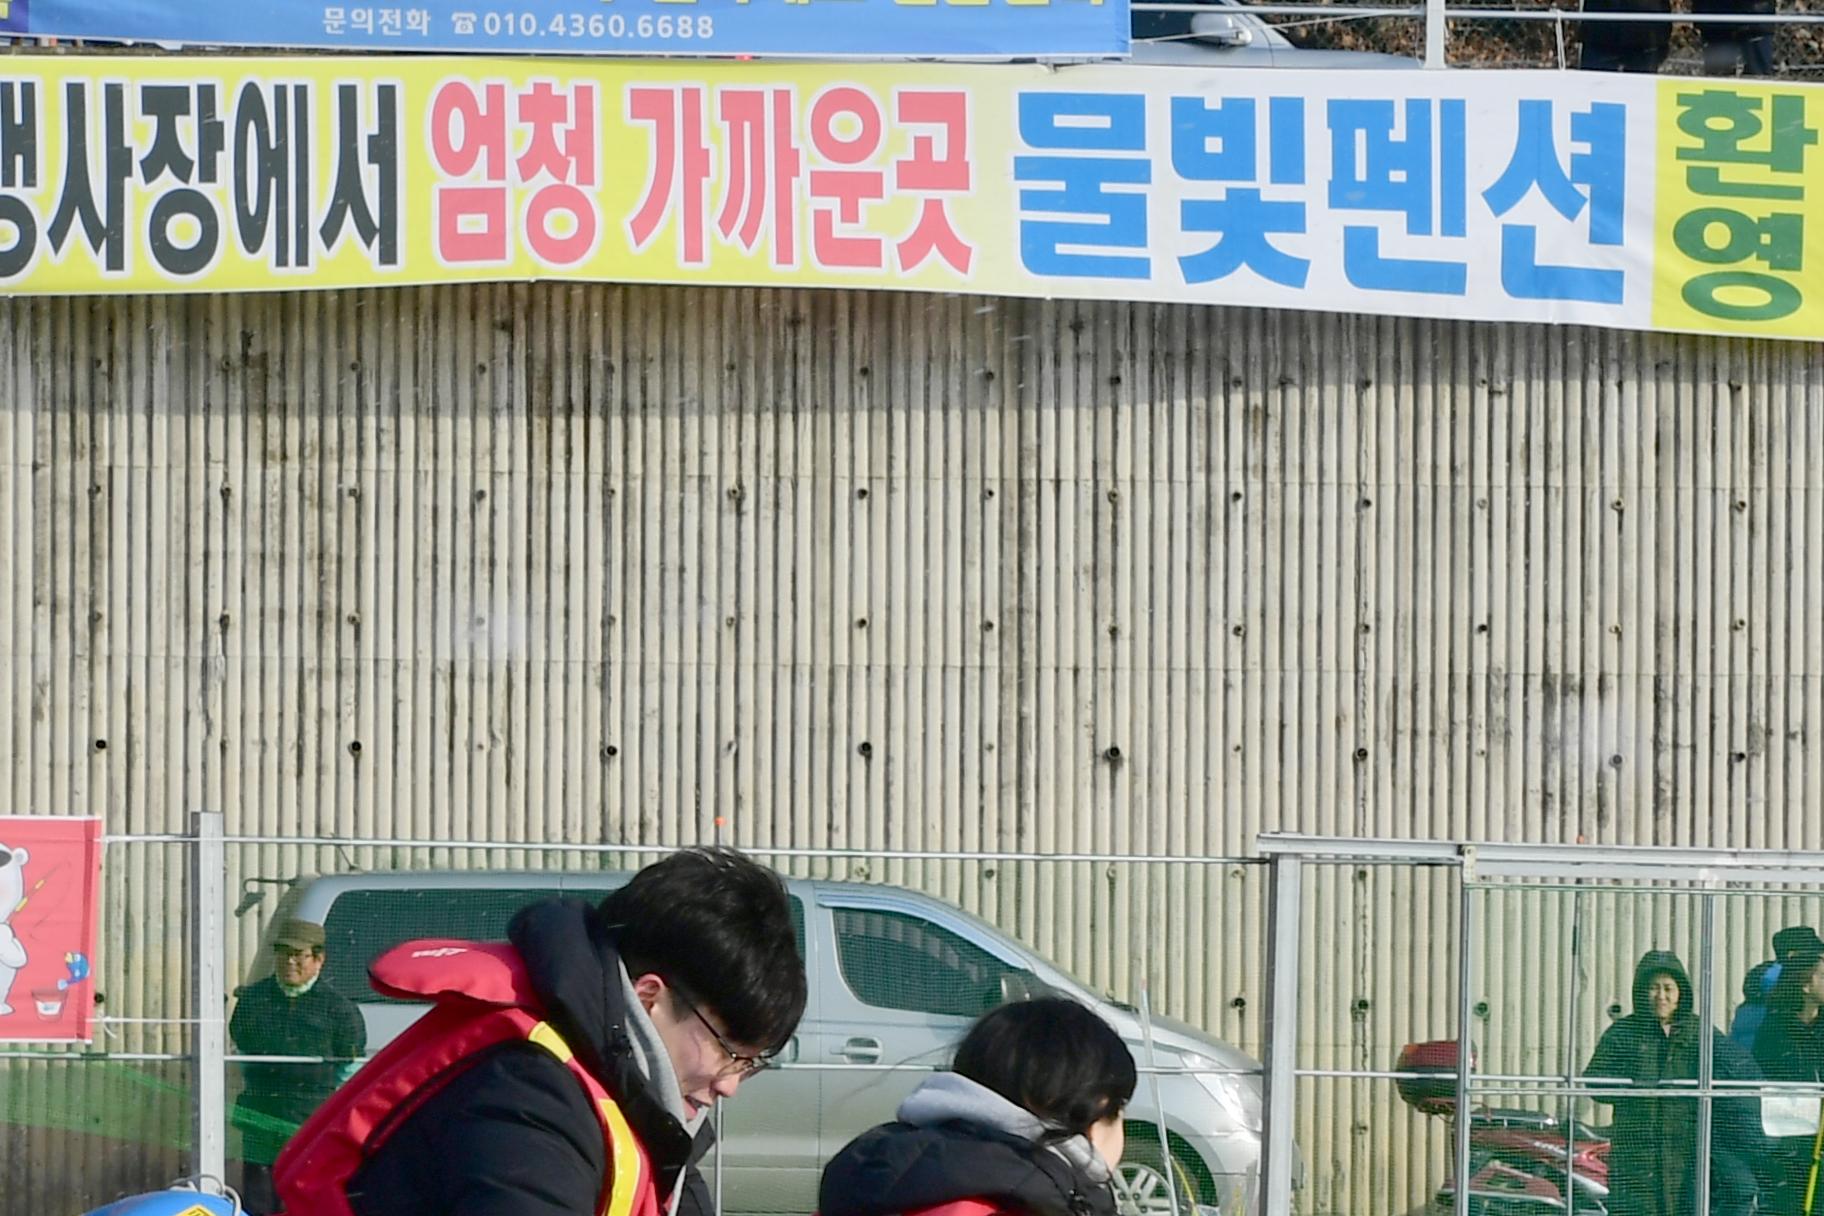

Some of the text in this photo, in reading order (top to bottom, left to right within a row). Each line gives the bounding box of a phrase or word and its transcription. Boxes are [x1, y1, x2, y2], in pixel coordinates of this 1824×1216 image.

[322, 7, 714, 39] 문의전화 010.4360.6688
[431, 81, 600, 267] 엄청
[630, 86, 973, 273] 가까운곳
[1013, 91, 1626, 304] 물빛펜션
[1673, 88, 1819, 322] 환영
